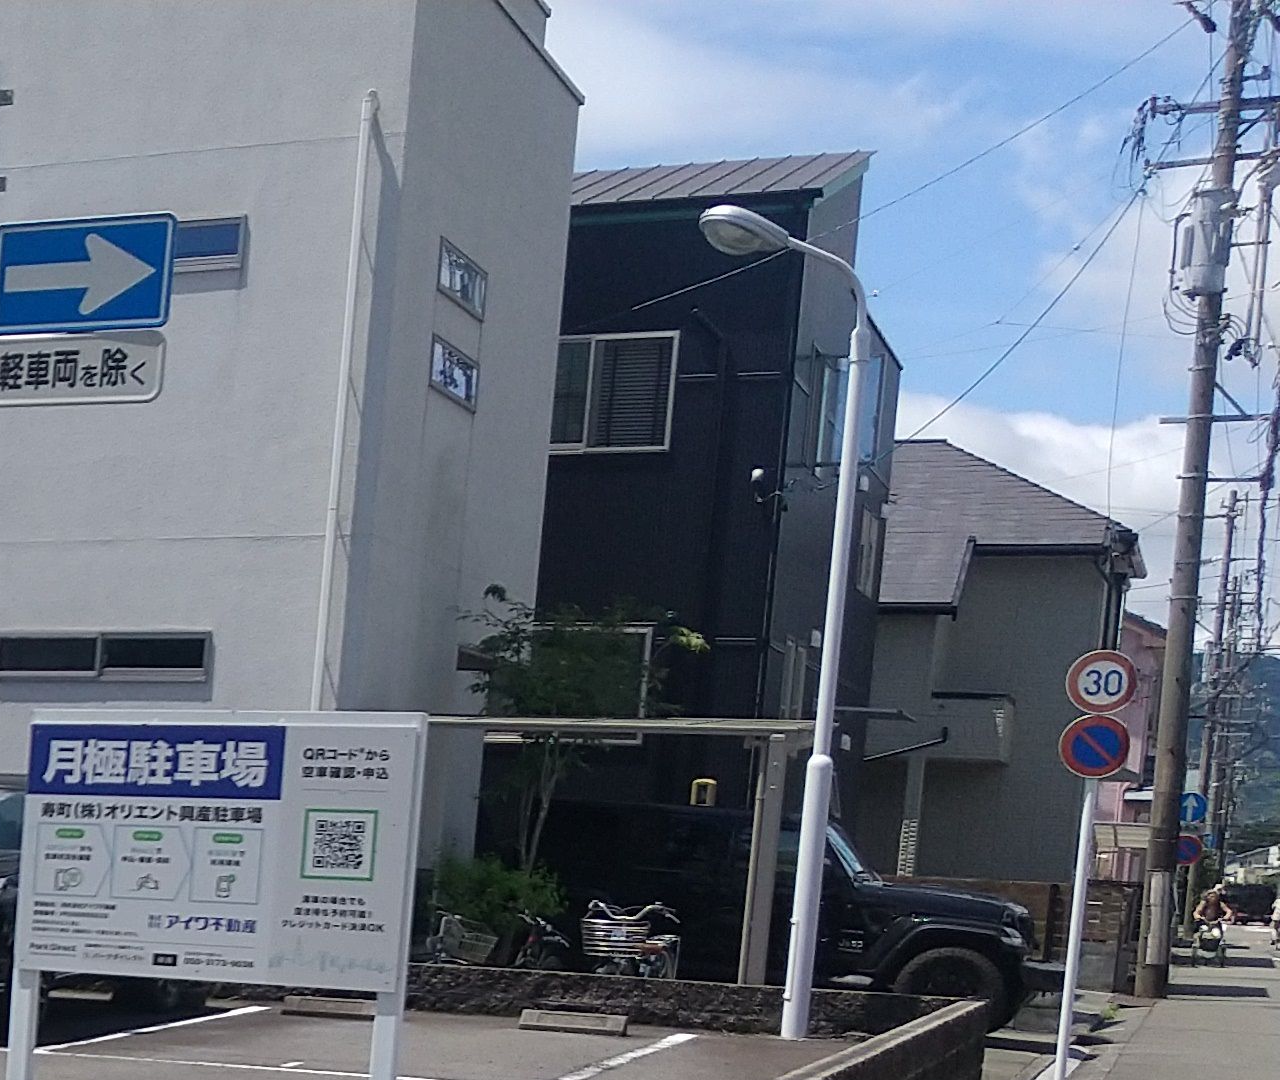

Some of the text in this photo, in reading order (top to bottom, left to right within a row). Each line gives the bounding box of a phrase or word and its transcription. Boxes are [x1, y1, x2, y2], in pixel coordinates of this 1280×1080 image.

[1083, 669, 1123, 697] 30
[42, 737, 269, 787] 月極駐車場
[165, 914, 257, 934] アイワ不動産
